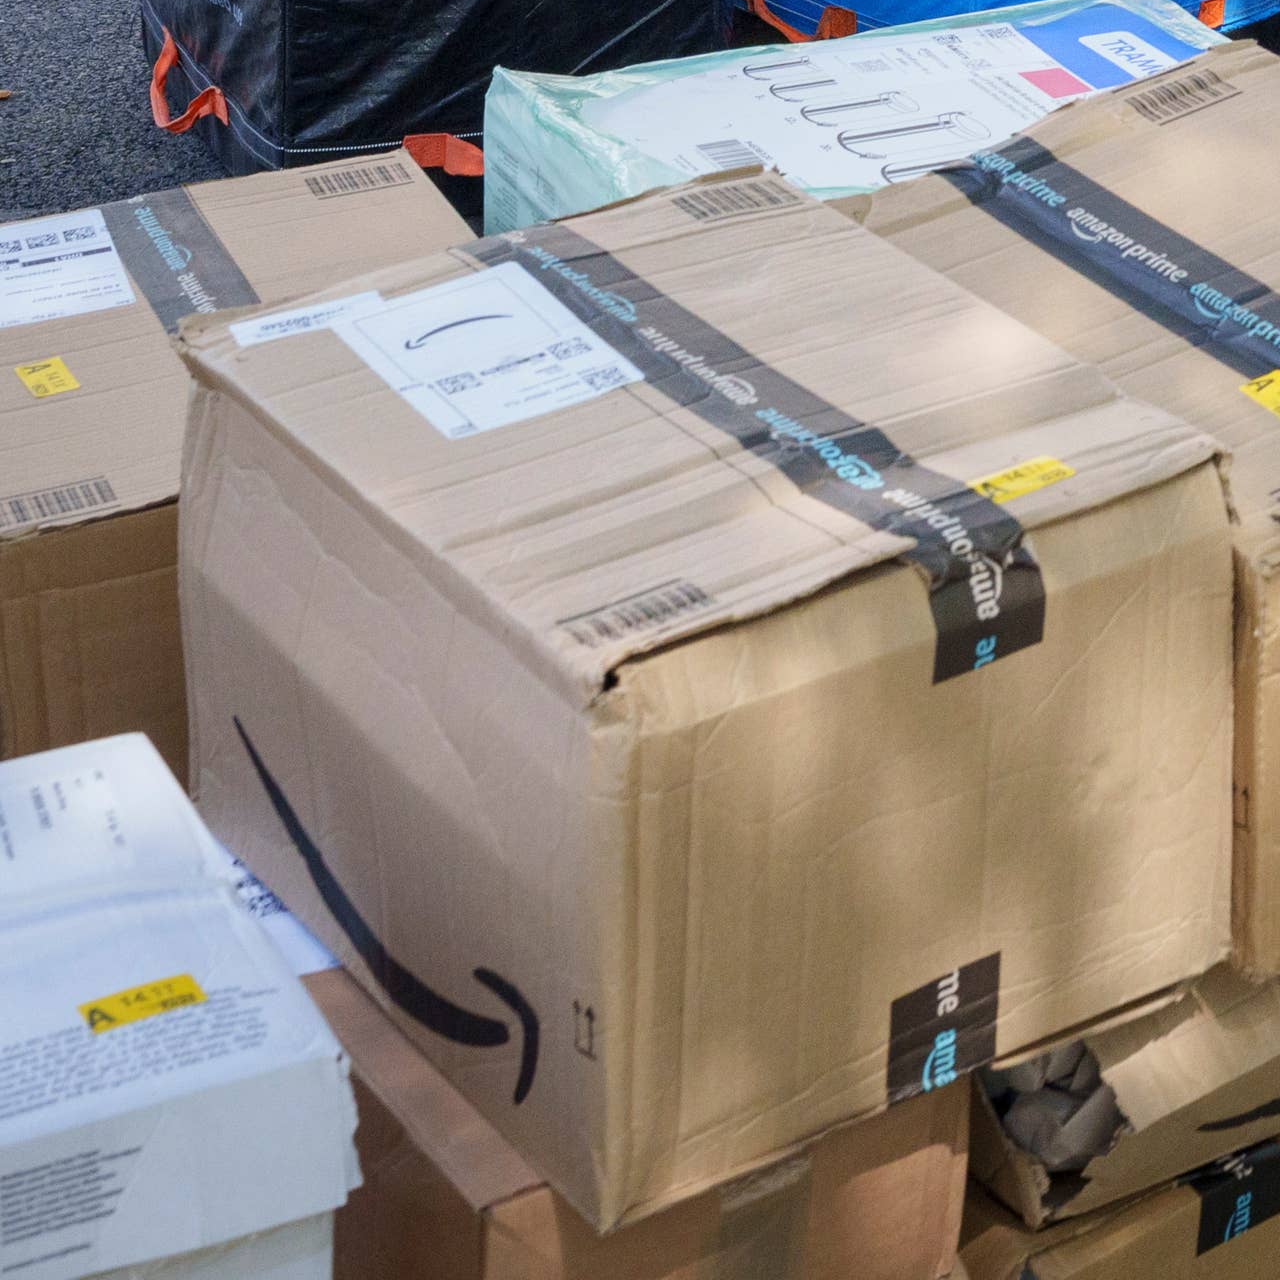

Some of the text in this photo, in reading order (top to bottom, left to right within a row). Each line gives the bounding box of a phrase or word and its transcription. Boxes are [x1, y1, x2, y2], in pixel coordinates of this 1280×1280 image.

[1002, 171, 1067, 208] prime
[1066, 207, 1134, 250] amazon
[1122, 240, 1189, 283] prime
[1188, 282, 1260, 329] amazon
[1251, 378, 1275, 393] A
[87, 1007, 118, 1030] A
